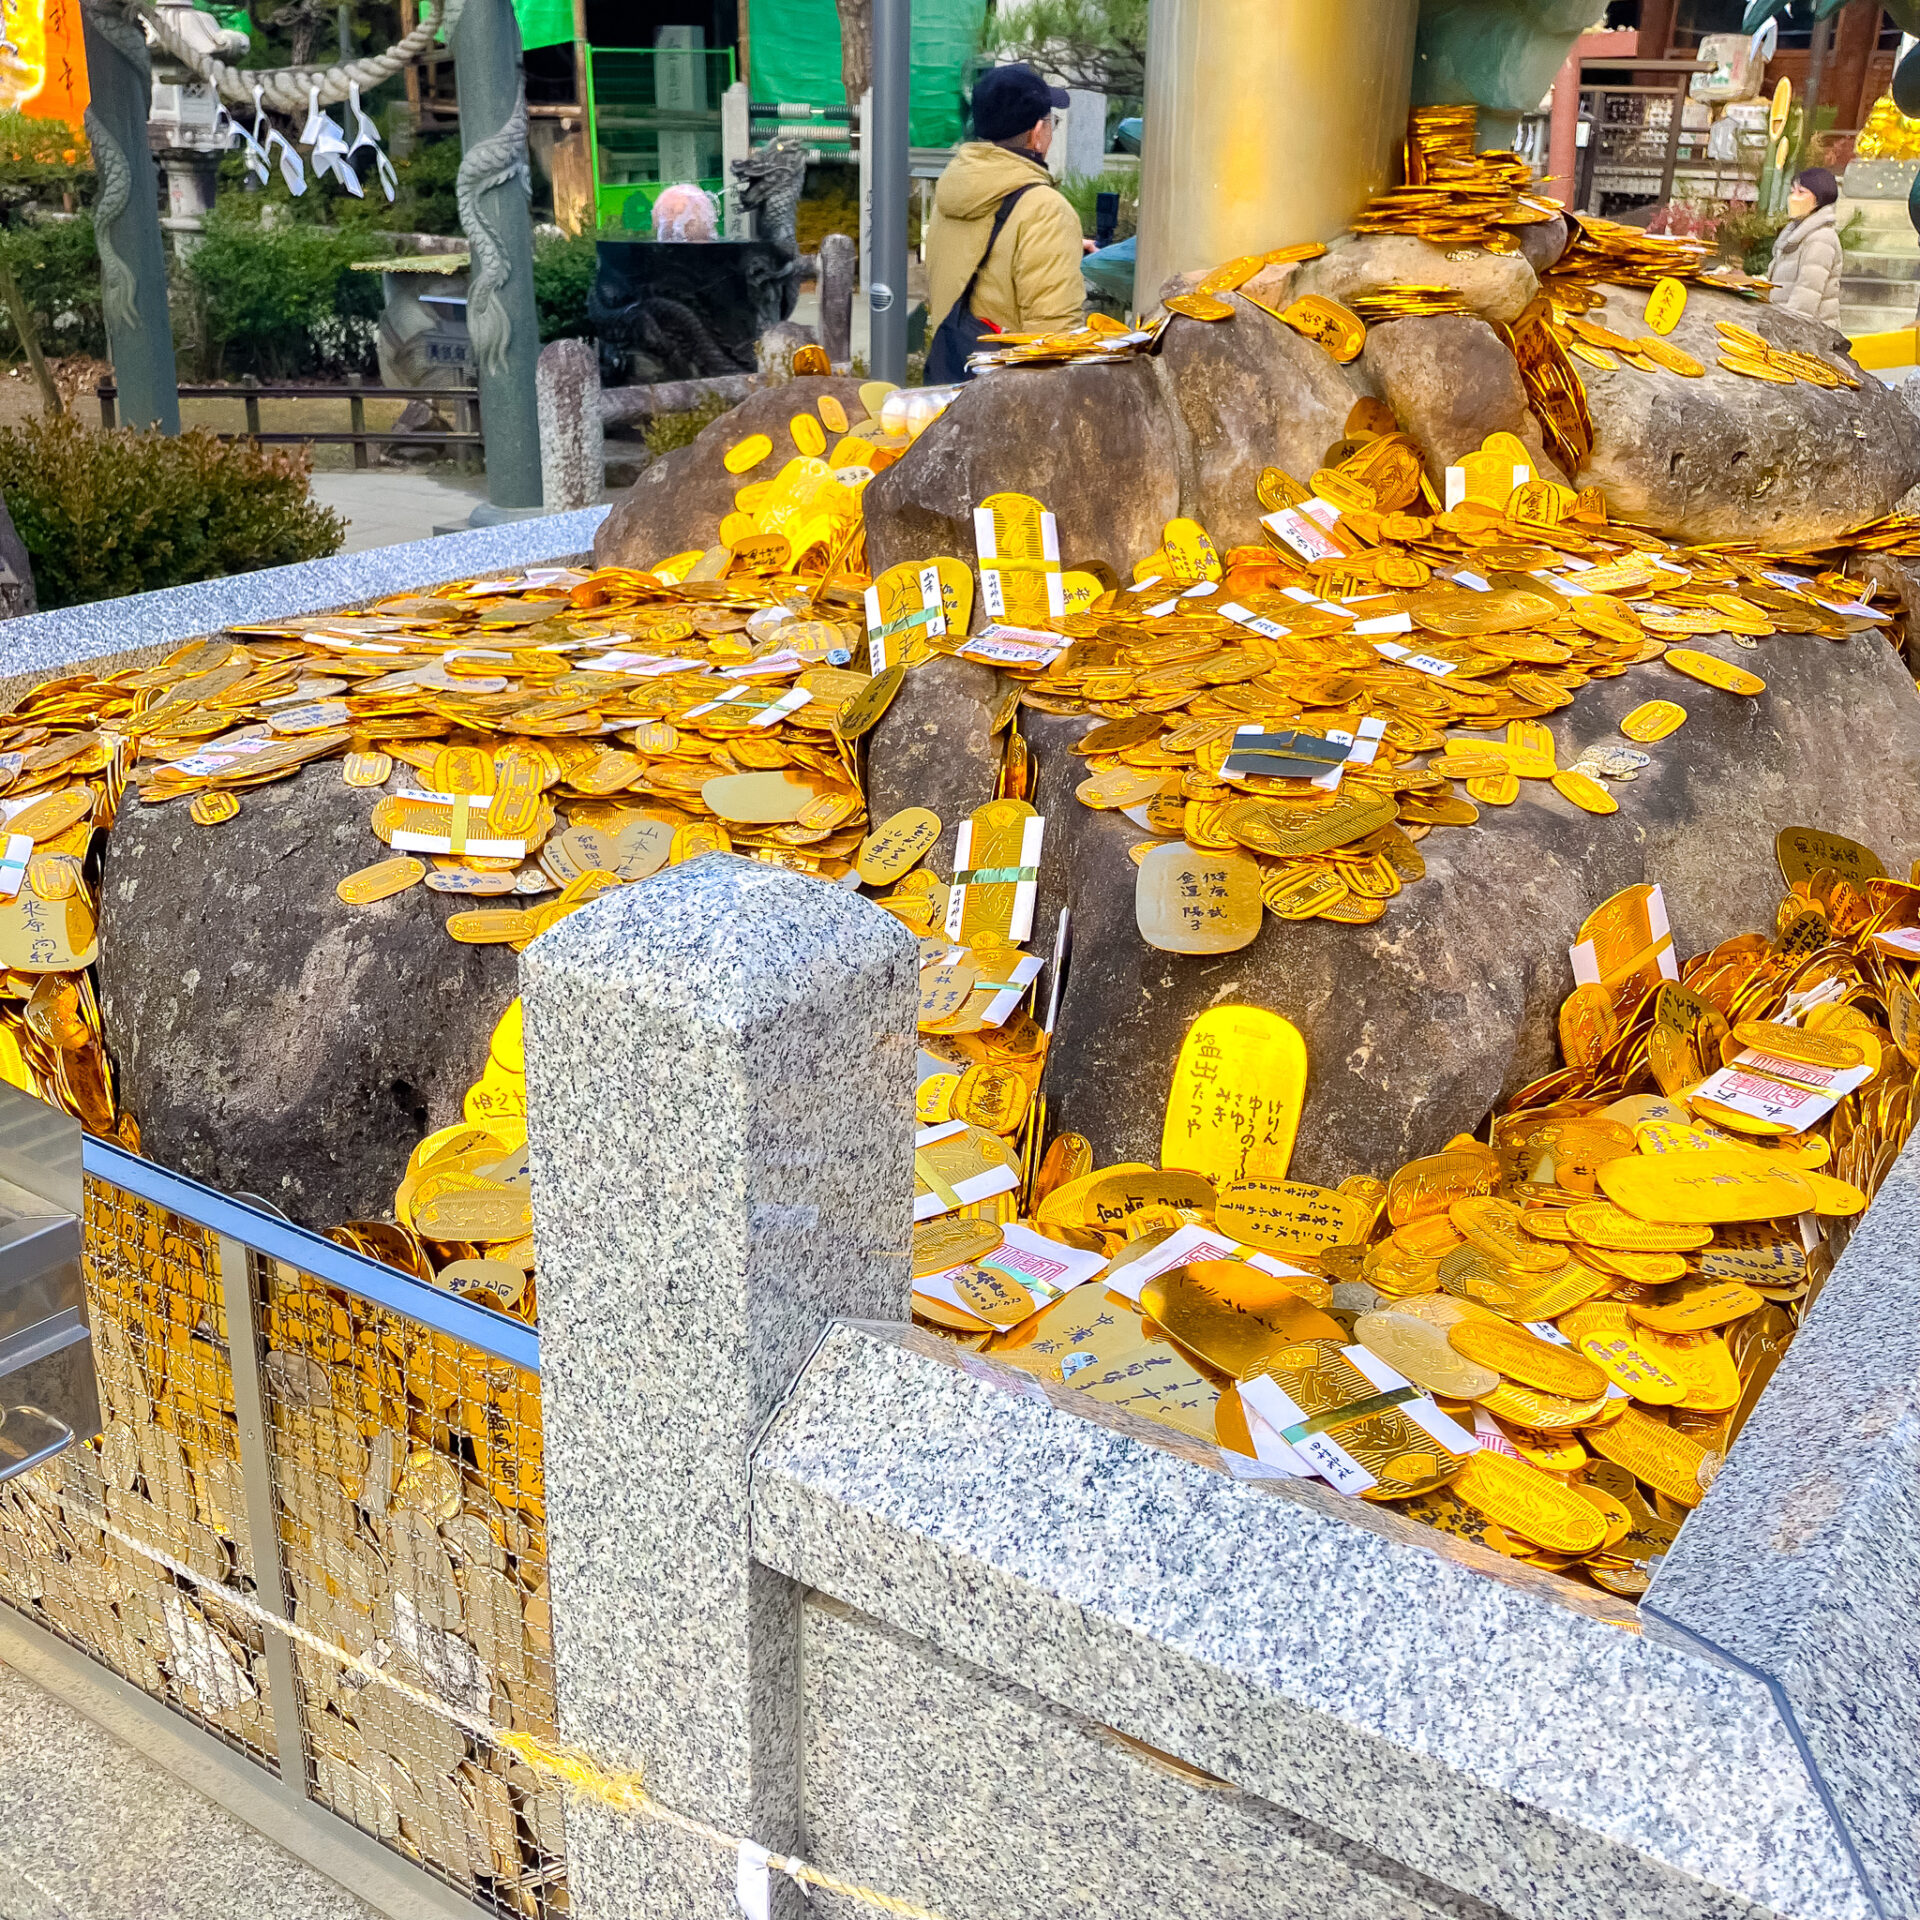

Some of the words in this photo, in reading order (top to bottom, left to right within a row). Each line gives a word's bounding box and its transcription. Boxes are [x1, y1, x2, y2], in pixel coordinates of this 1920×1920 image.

[987, 573, 1001, 608] 田村神社
[949, 888, 963, 928] 田村神社
[1212, 1086, 1232, 1129] みき
[1231, 1093, 1245, 1134] さゆ
[1309, 1441, 1356, 1481] 田村神社
